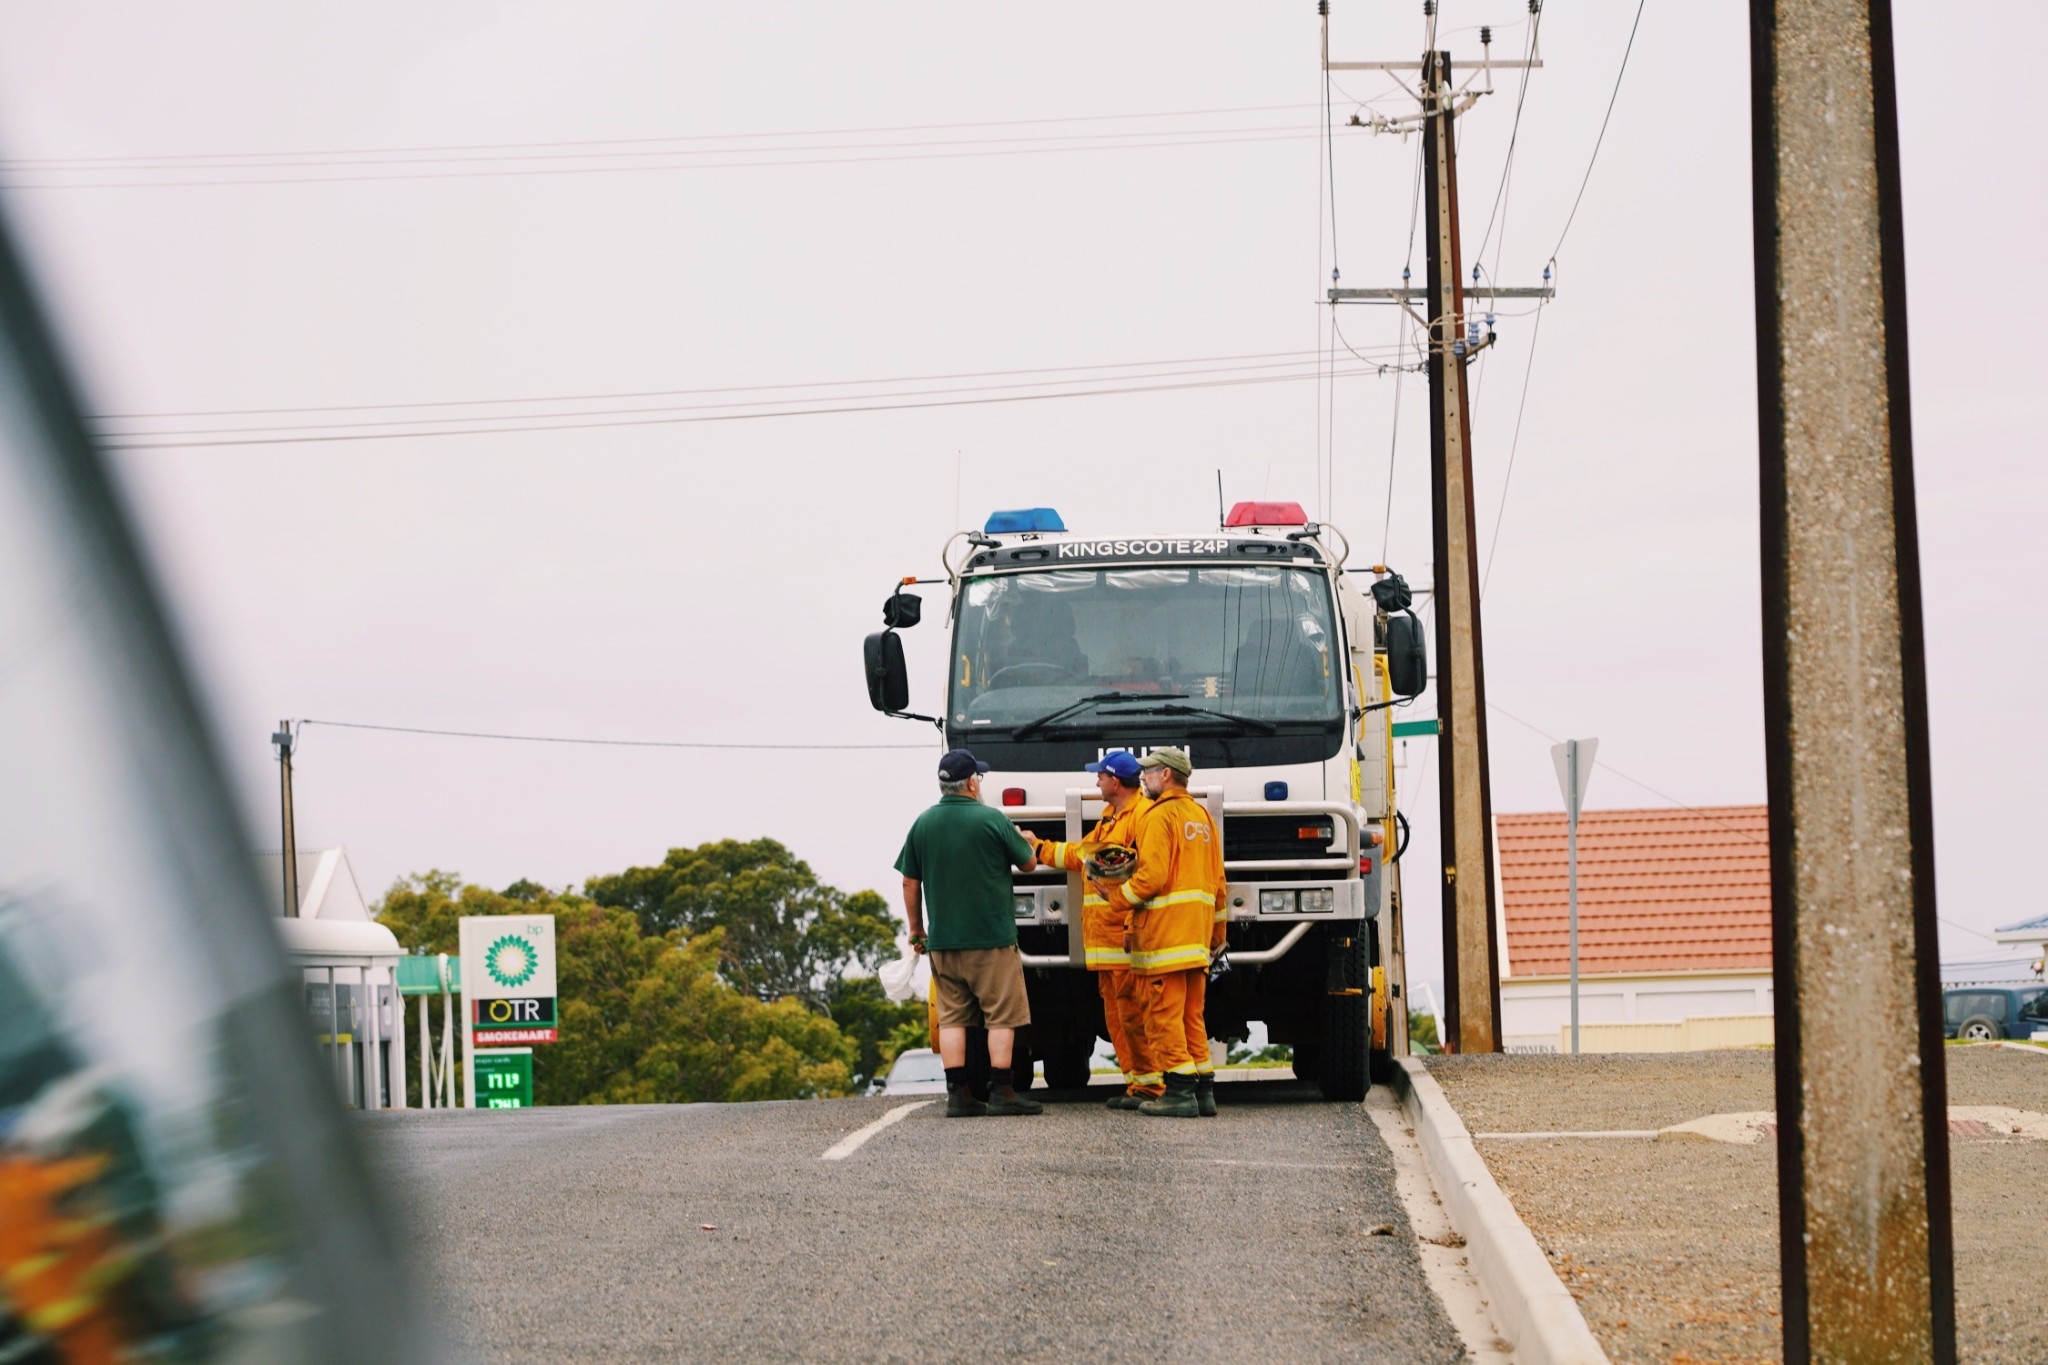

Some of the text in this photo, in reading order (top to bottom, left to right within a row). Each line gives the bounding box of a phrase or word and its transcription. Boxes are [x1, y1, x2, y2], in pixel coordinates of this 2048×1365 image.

[1058, 539, 1229, 558] KINGSCOTE 24P
[1184, 820, 1211, 844] CFS
[527, 924, 543, 936] bp
[489, 999, 540, 1023] OTR
[477, 1029, 552, 1043] SMOKEMART
